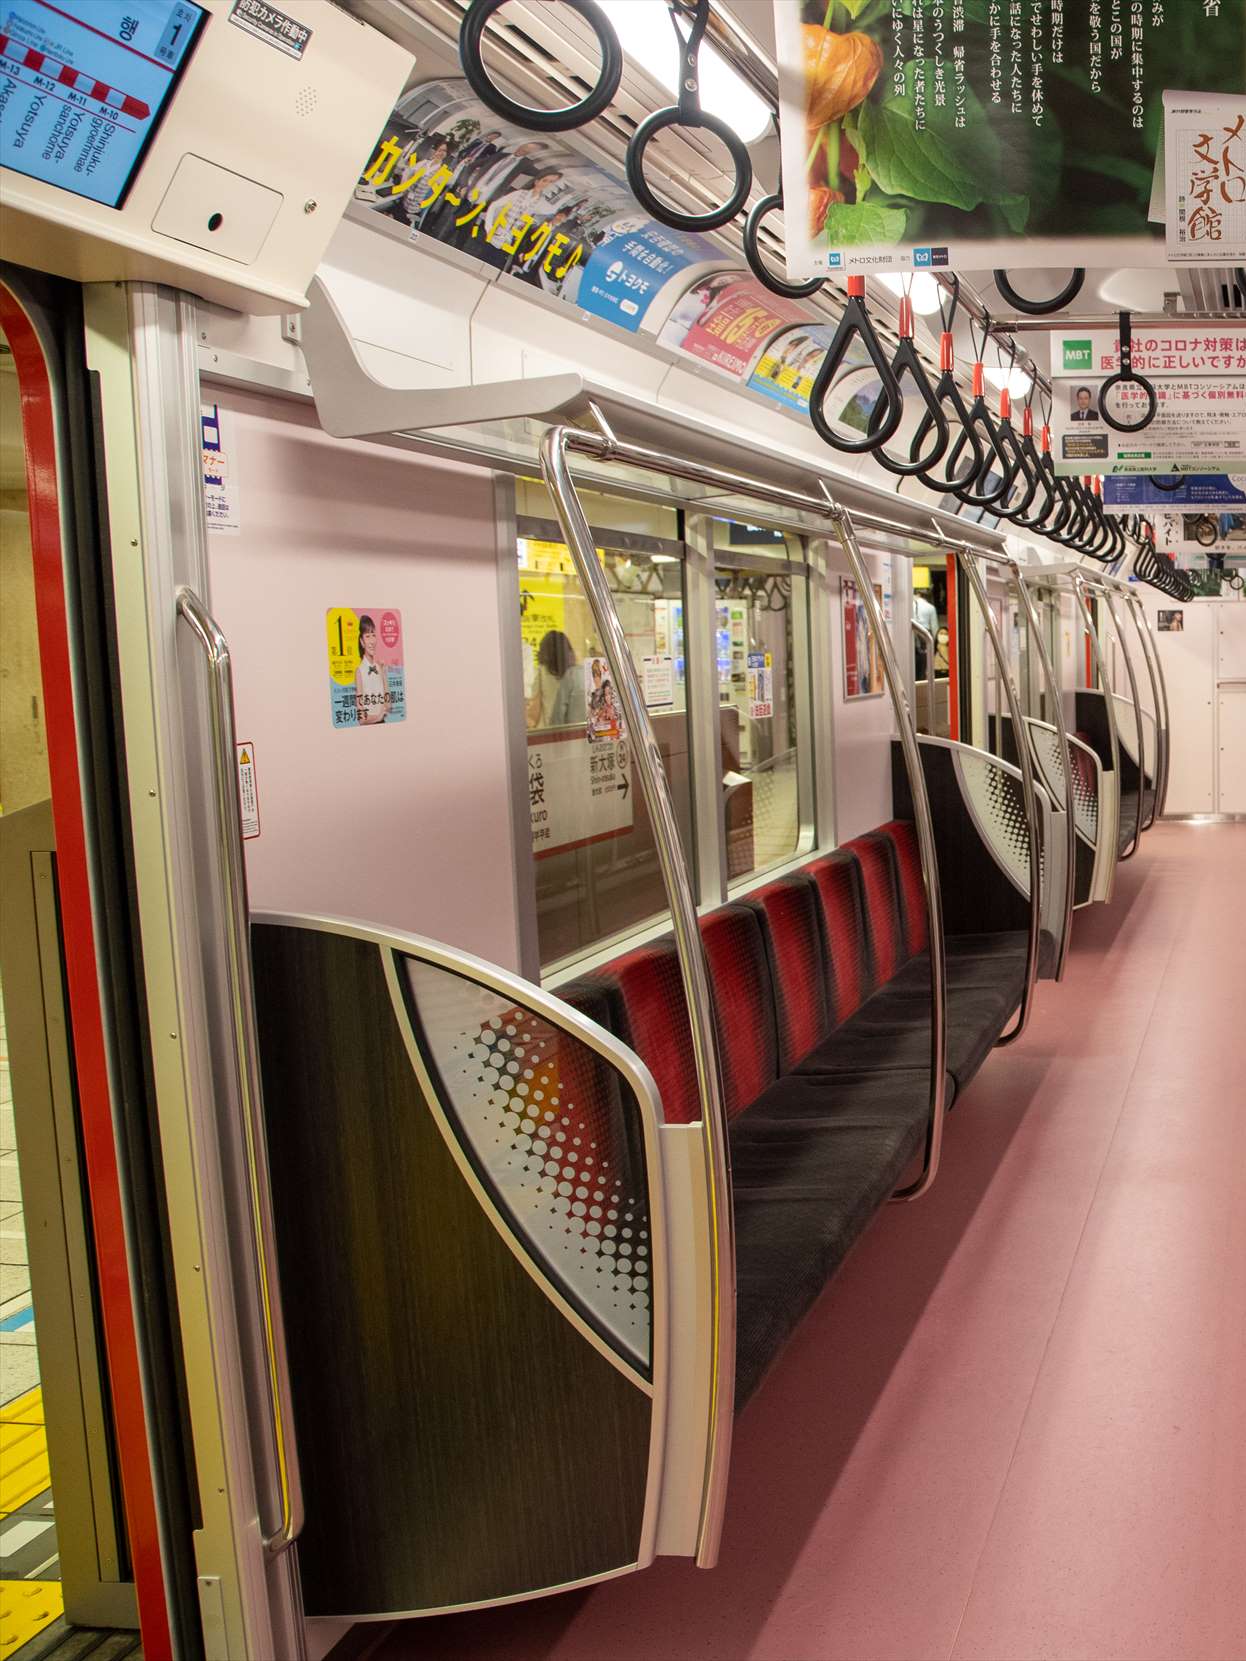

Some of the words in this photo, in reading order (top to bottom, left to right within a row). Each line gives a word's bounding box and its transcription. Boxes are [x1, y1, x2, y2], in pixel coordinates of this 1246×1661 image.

[168, 24, 182, 46] 1
[1151, 0, 1164, 27] みが
[989, 0, 1002, 104] かに手を合わせる
[1009, 0, 1023, 114] 話になった人たちに
[1030, 0, 1044, 127] でせわしい手を休めて
[1089, 0, 1102, 94] を敬う国だから
[1130, 0, 1144, 129] の時期に集中するのは
[32, 76, 57, 92] M-12
[67, 91, 87, 107] M-11
[953, 46, 966, 128] 帰省ラッシュは
[13, 95, 47, 149] Yotsuya
[41, 104, 72, 161] sanchome
[55, 111, 86, 164] Yotsuya-
[99, 105, 119, 121] M-10
[85, 123, 116, 177] Shinjuku-
[614, 268, 650, 295] トヨクモ
[1064, 350, 1090, 361] MBT
